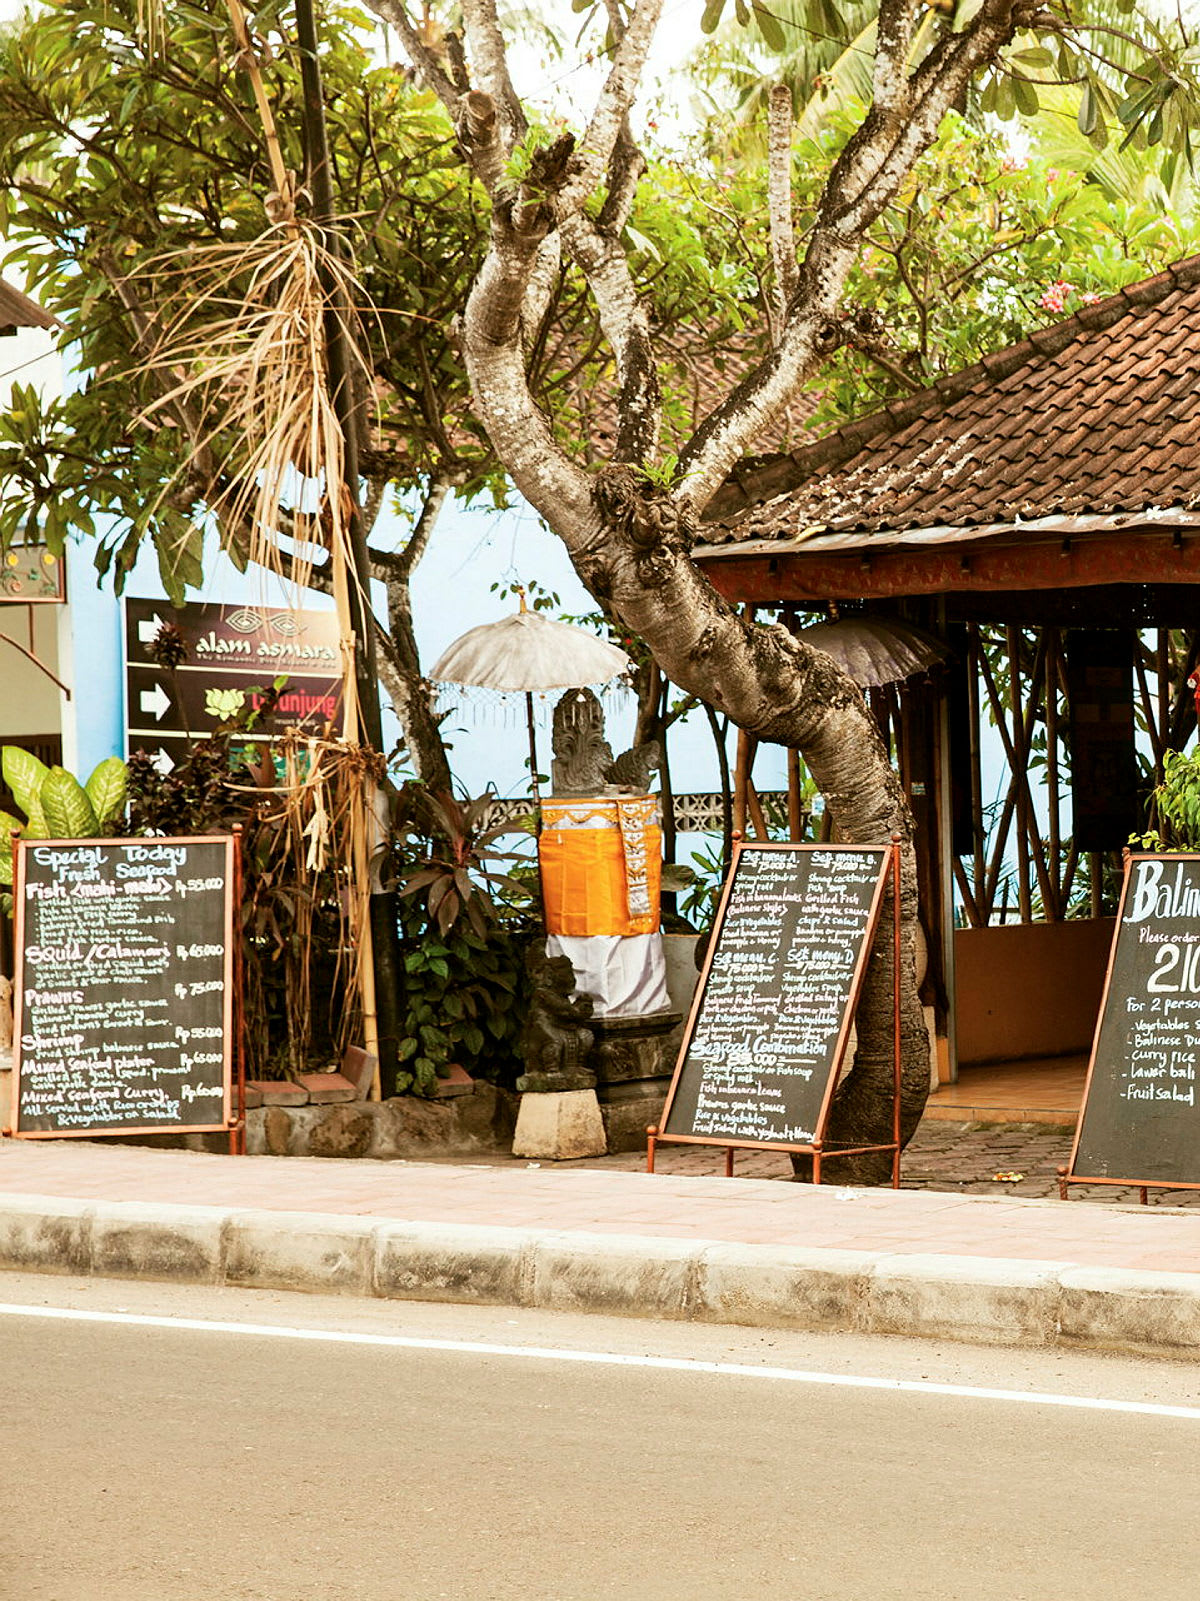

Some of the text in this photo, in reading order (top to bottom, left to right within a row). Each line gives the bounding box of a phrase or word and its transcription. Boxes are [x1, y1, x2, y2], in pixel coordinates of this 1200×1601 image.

[196, 631, 337, 660] alam asmara
[34, 845, 187, 872] Special Today
[26, 879, 67, 900] Fish
[1139, 926, 1169, 943] Please
[1171, 931, 1199, 943] order
[1126, 997, 1146, 1012] For
[1150, 997, 1161, 1012] 2
[1134, 1032, 1182, 1049] Balinese
